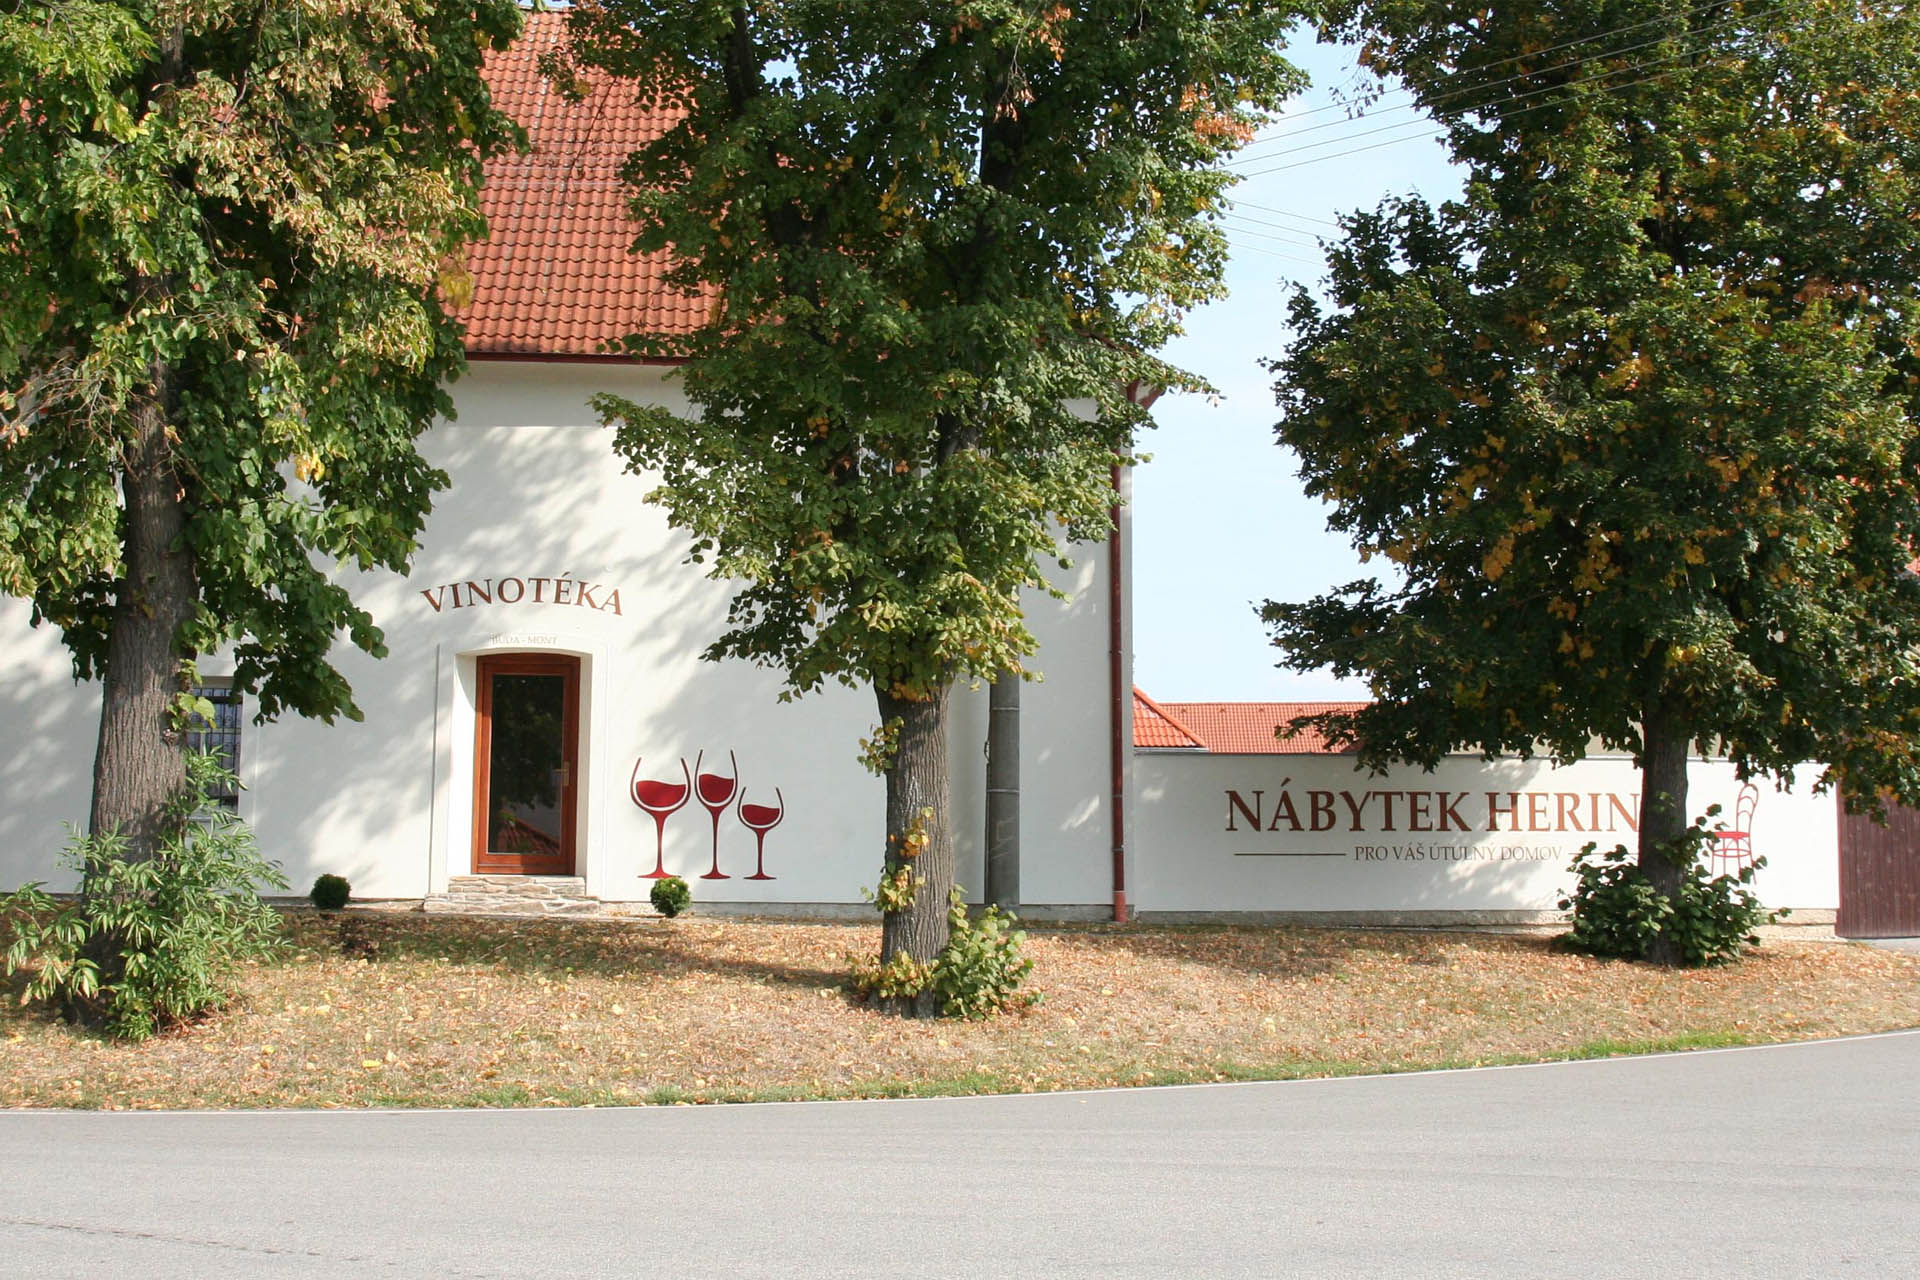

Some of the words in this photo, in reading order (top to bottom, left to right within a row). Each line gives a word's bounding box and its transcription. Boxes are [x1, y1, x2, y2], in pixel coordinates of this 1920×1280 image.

[420, 571, 623, 616] VINOTÉKA
[1225, 777, 1472, 832] NÁBYTEK
[1354, 846, 1388, 861] PRO
[1391, 842, 1425, 861] VÁŠ
[1429, 842, 1497, 861] ÚTULNÝ
[1500, 846, 1562, 861] DOMOV
